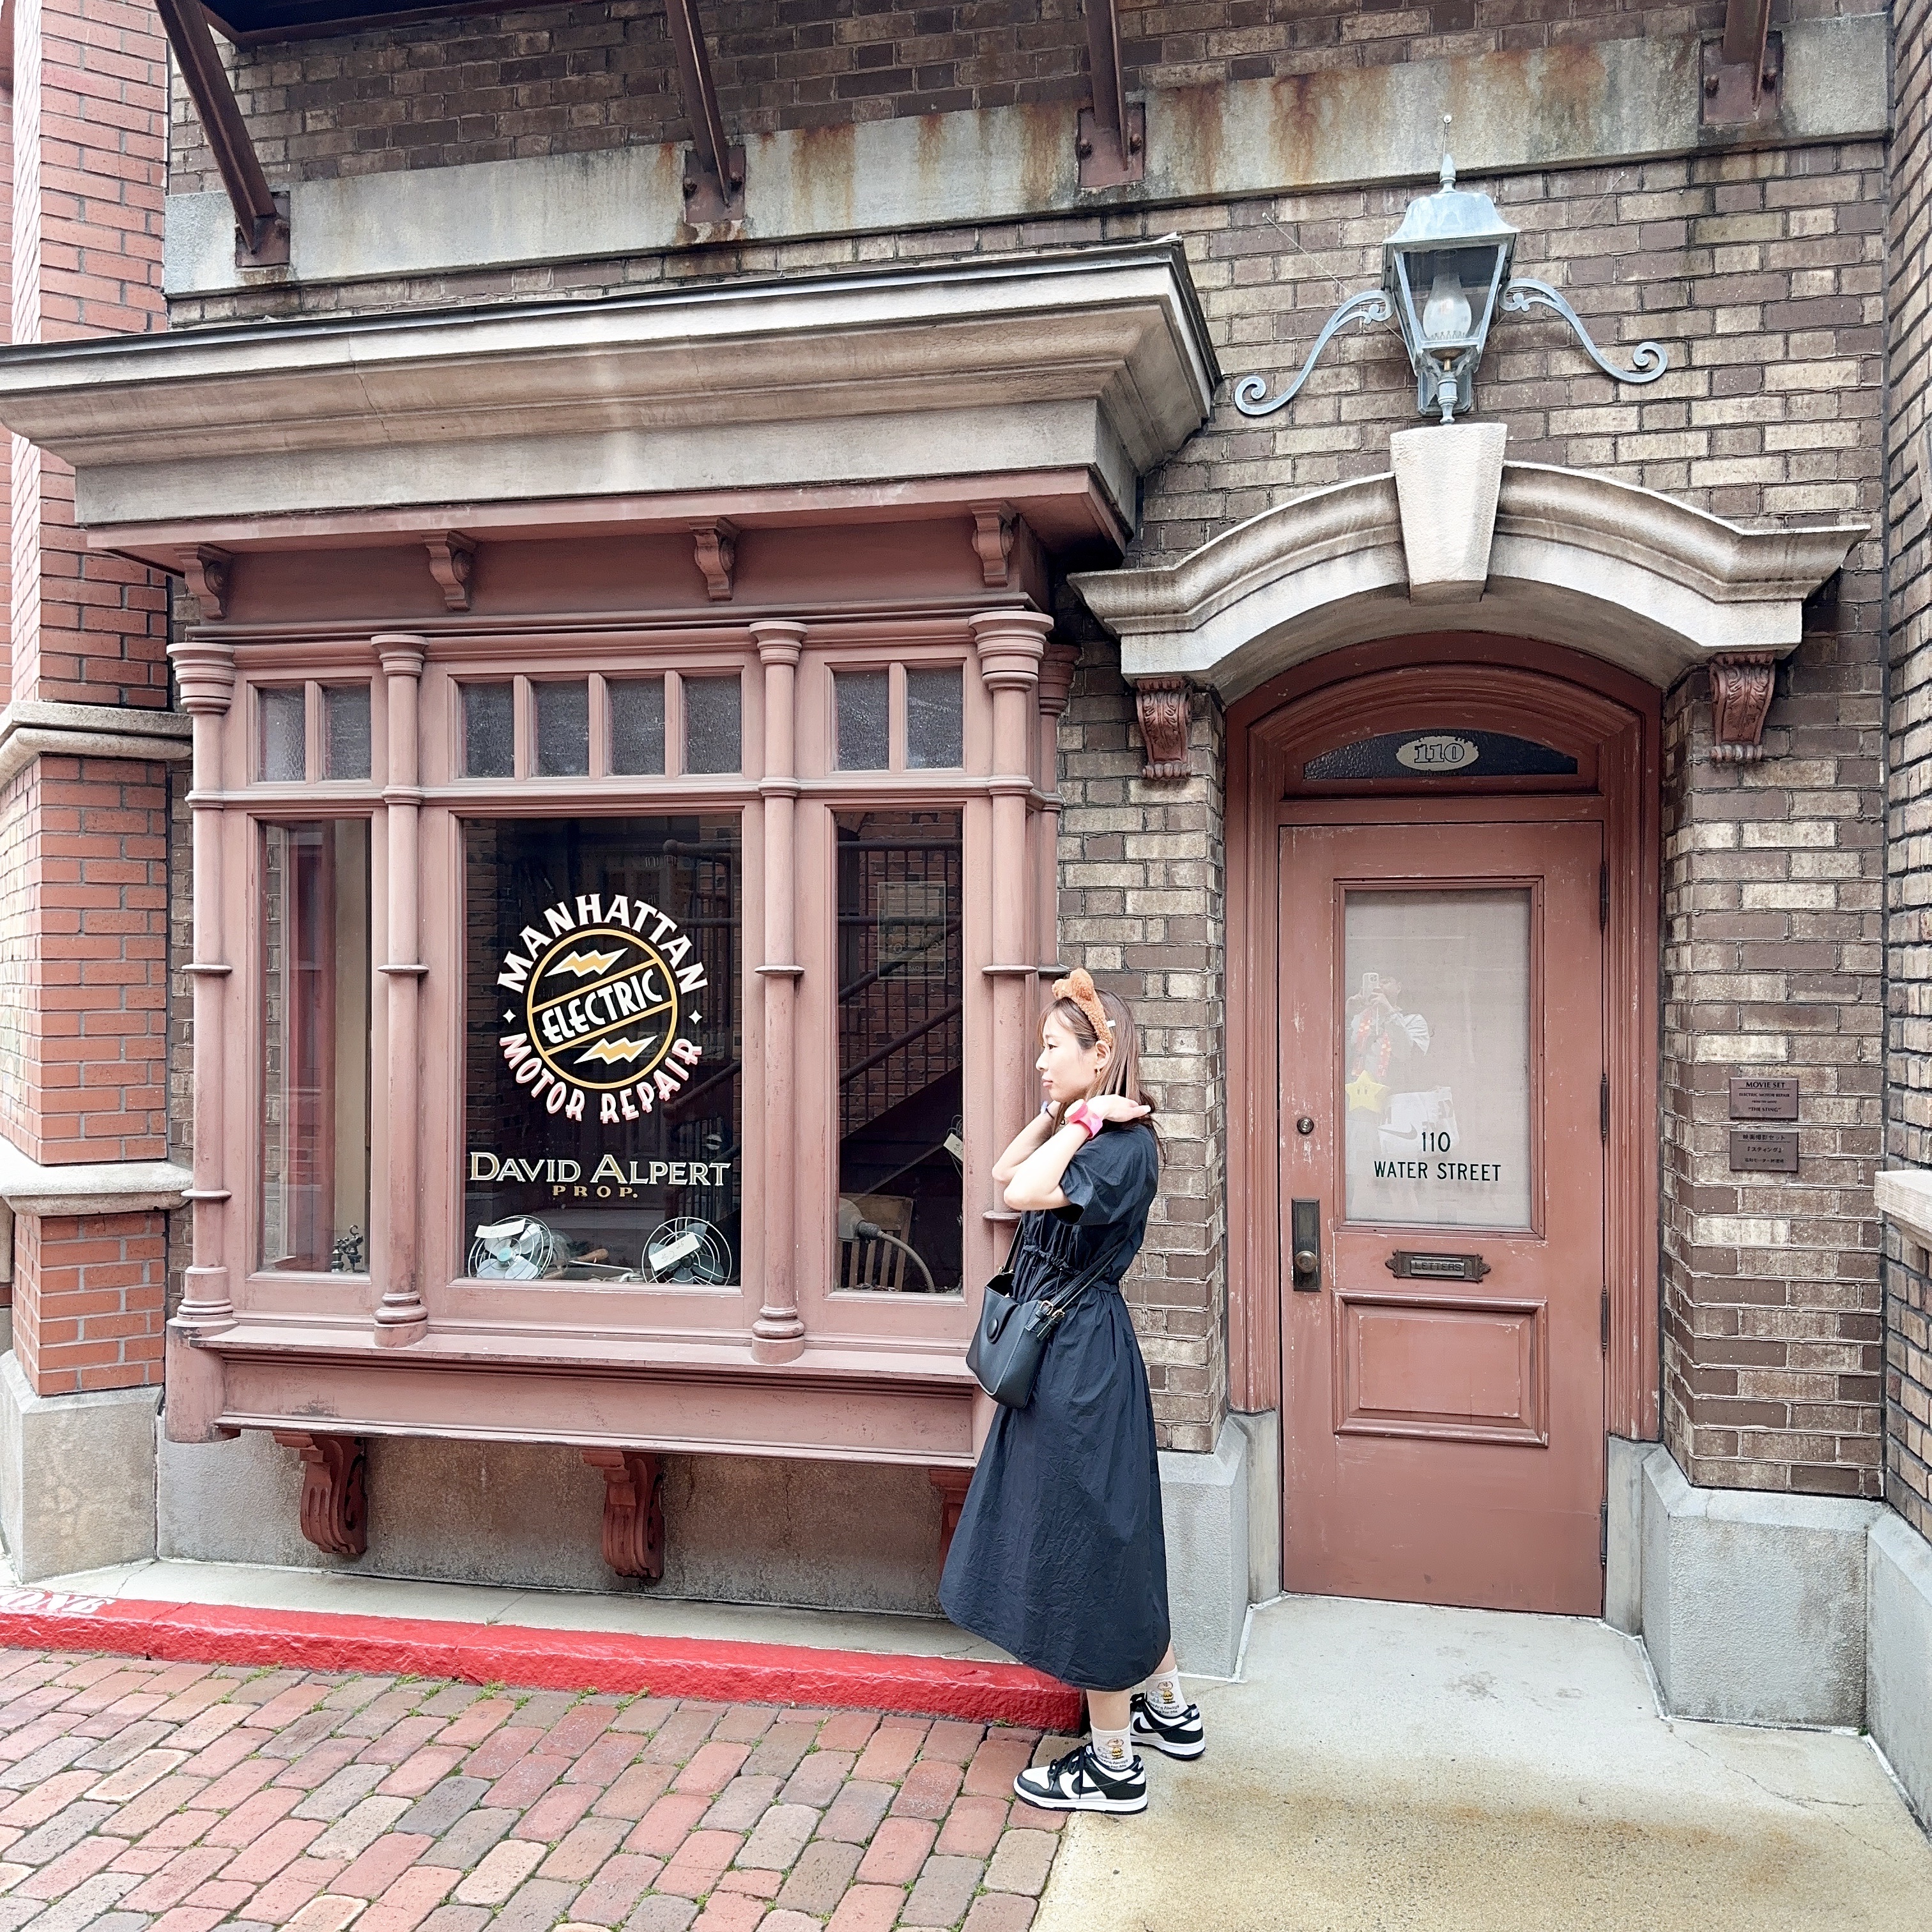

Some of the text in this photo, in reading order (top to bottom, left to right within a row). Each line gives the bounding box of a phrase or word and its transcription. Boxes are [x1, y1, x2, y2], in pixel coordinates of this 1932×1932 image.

[1414, 742, 1465, 763] 110
[497, 893, 708, 995] MANHATTAN
[542, 969, 663, 1045] ELECTRIC
[499, 1032, 703, 1124] MOTOR REPAIR
[1422, 1131, 1451, 1152] 110
[1374, 1160, 1501, 1181] WATER STREET
[552, 1185, 638, 1198] PROP.
[1414, 1262, 1462, 1271] LETTERS
